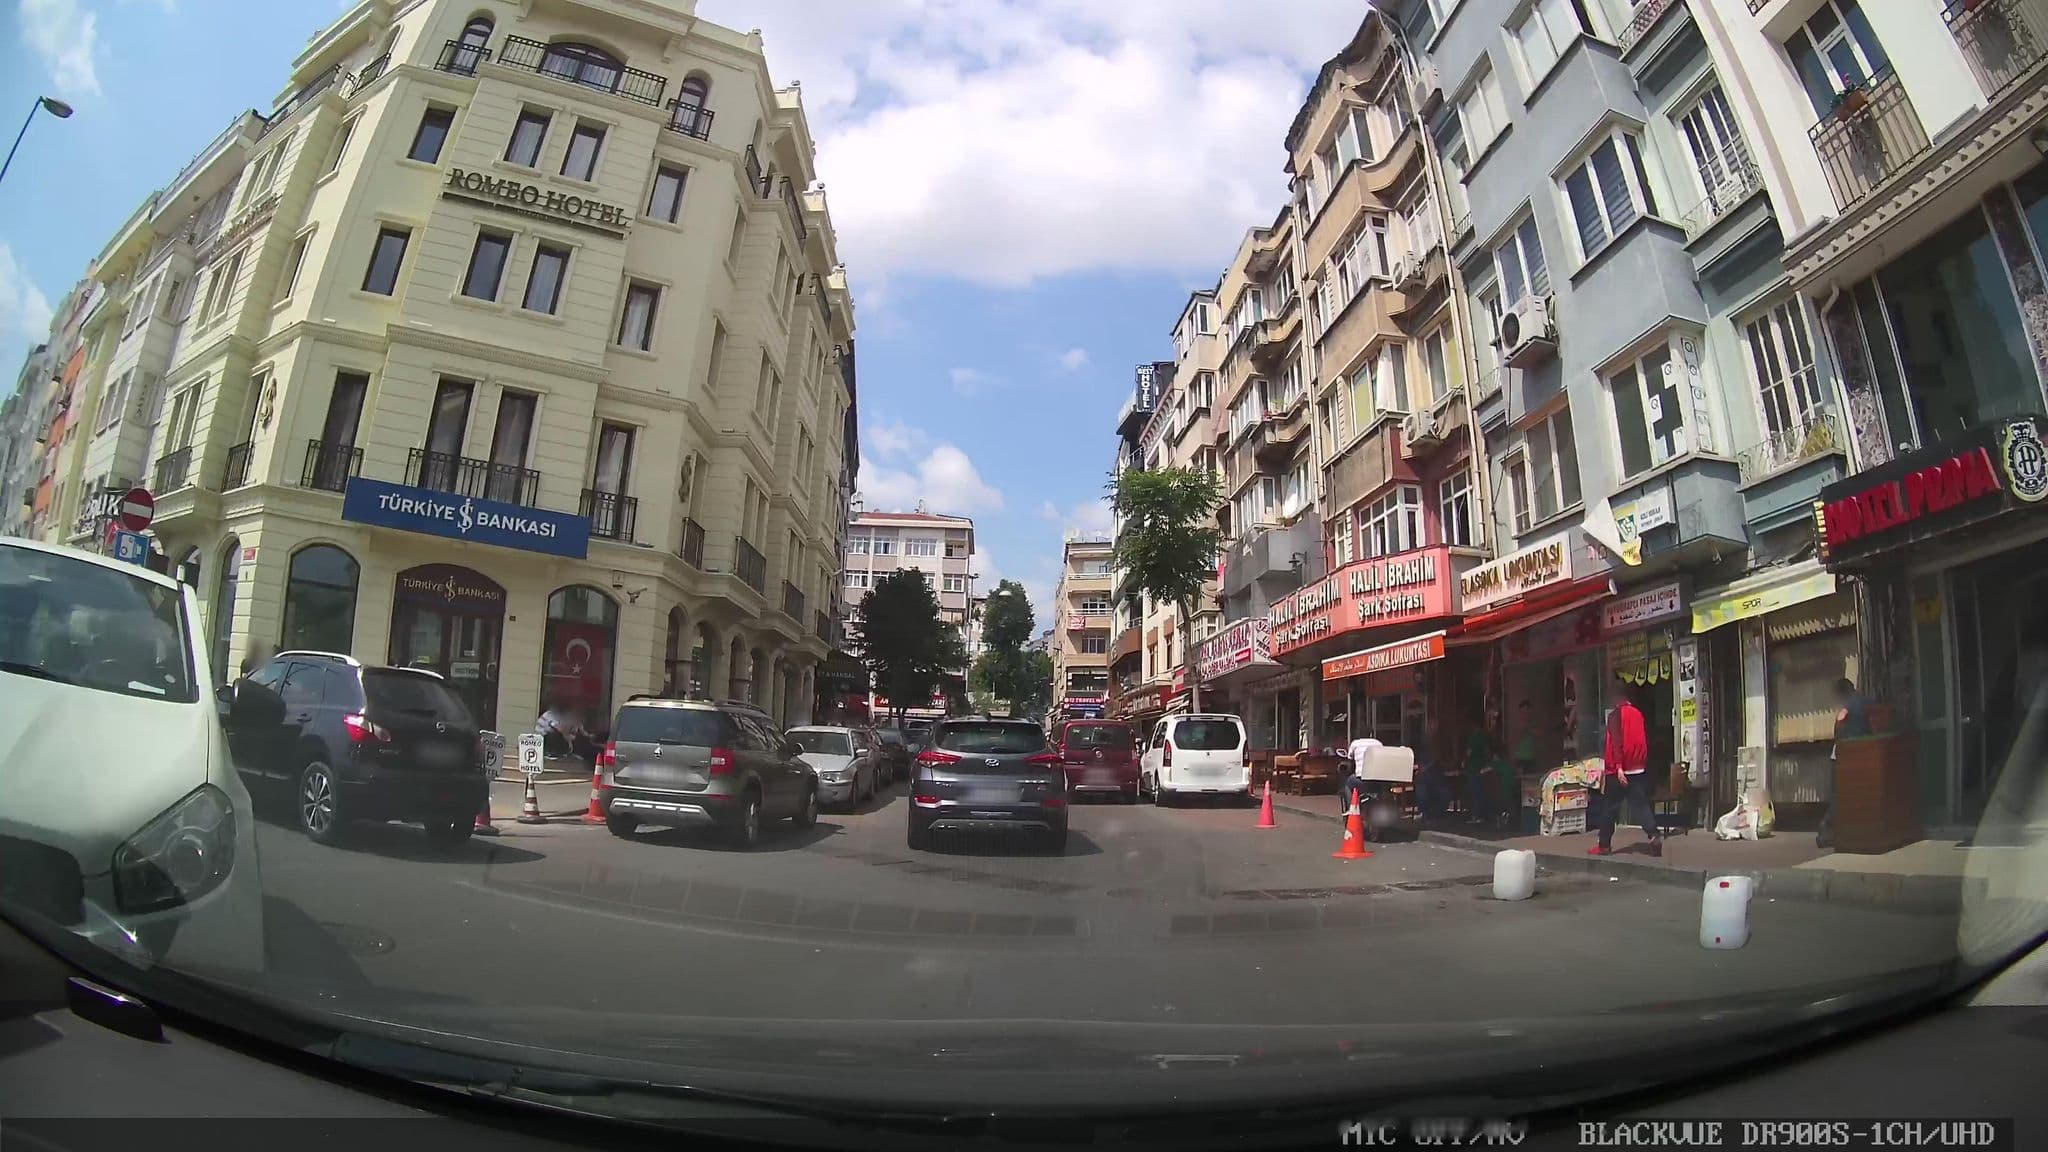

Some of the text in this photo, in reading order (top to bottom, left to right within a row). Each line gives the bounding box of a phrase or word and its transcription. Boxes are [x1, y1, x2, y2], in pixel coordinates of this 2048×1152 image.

[446, 168, 539, 205] ROMEO
[541, 190, 630, 227] HOTEL
[1141, 374, 1151, 408] HOTEL
[378, 493, 455, 520] TÜRKİYE
[477, 512, 556, 537] BANKASI
[1350, 553, 1435, 594] HALİL İBRAHİM
[403, 578, 443, 592] TÜRKİYE
[457, 586, 500, 601] BANKASI
[1742, 597, 1762, 610] SPOR
[1358, 592, 1423, 620] Şark Sofrası
[483, 739, 503, 749] OMEO
[520, 740, 542, 748] ROMEO
